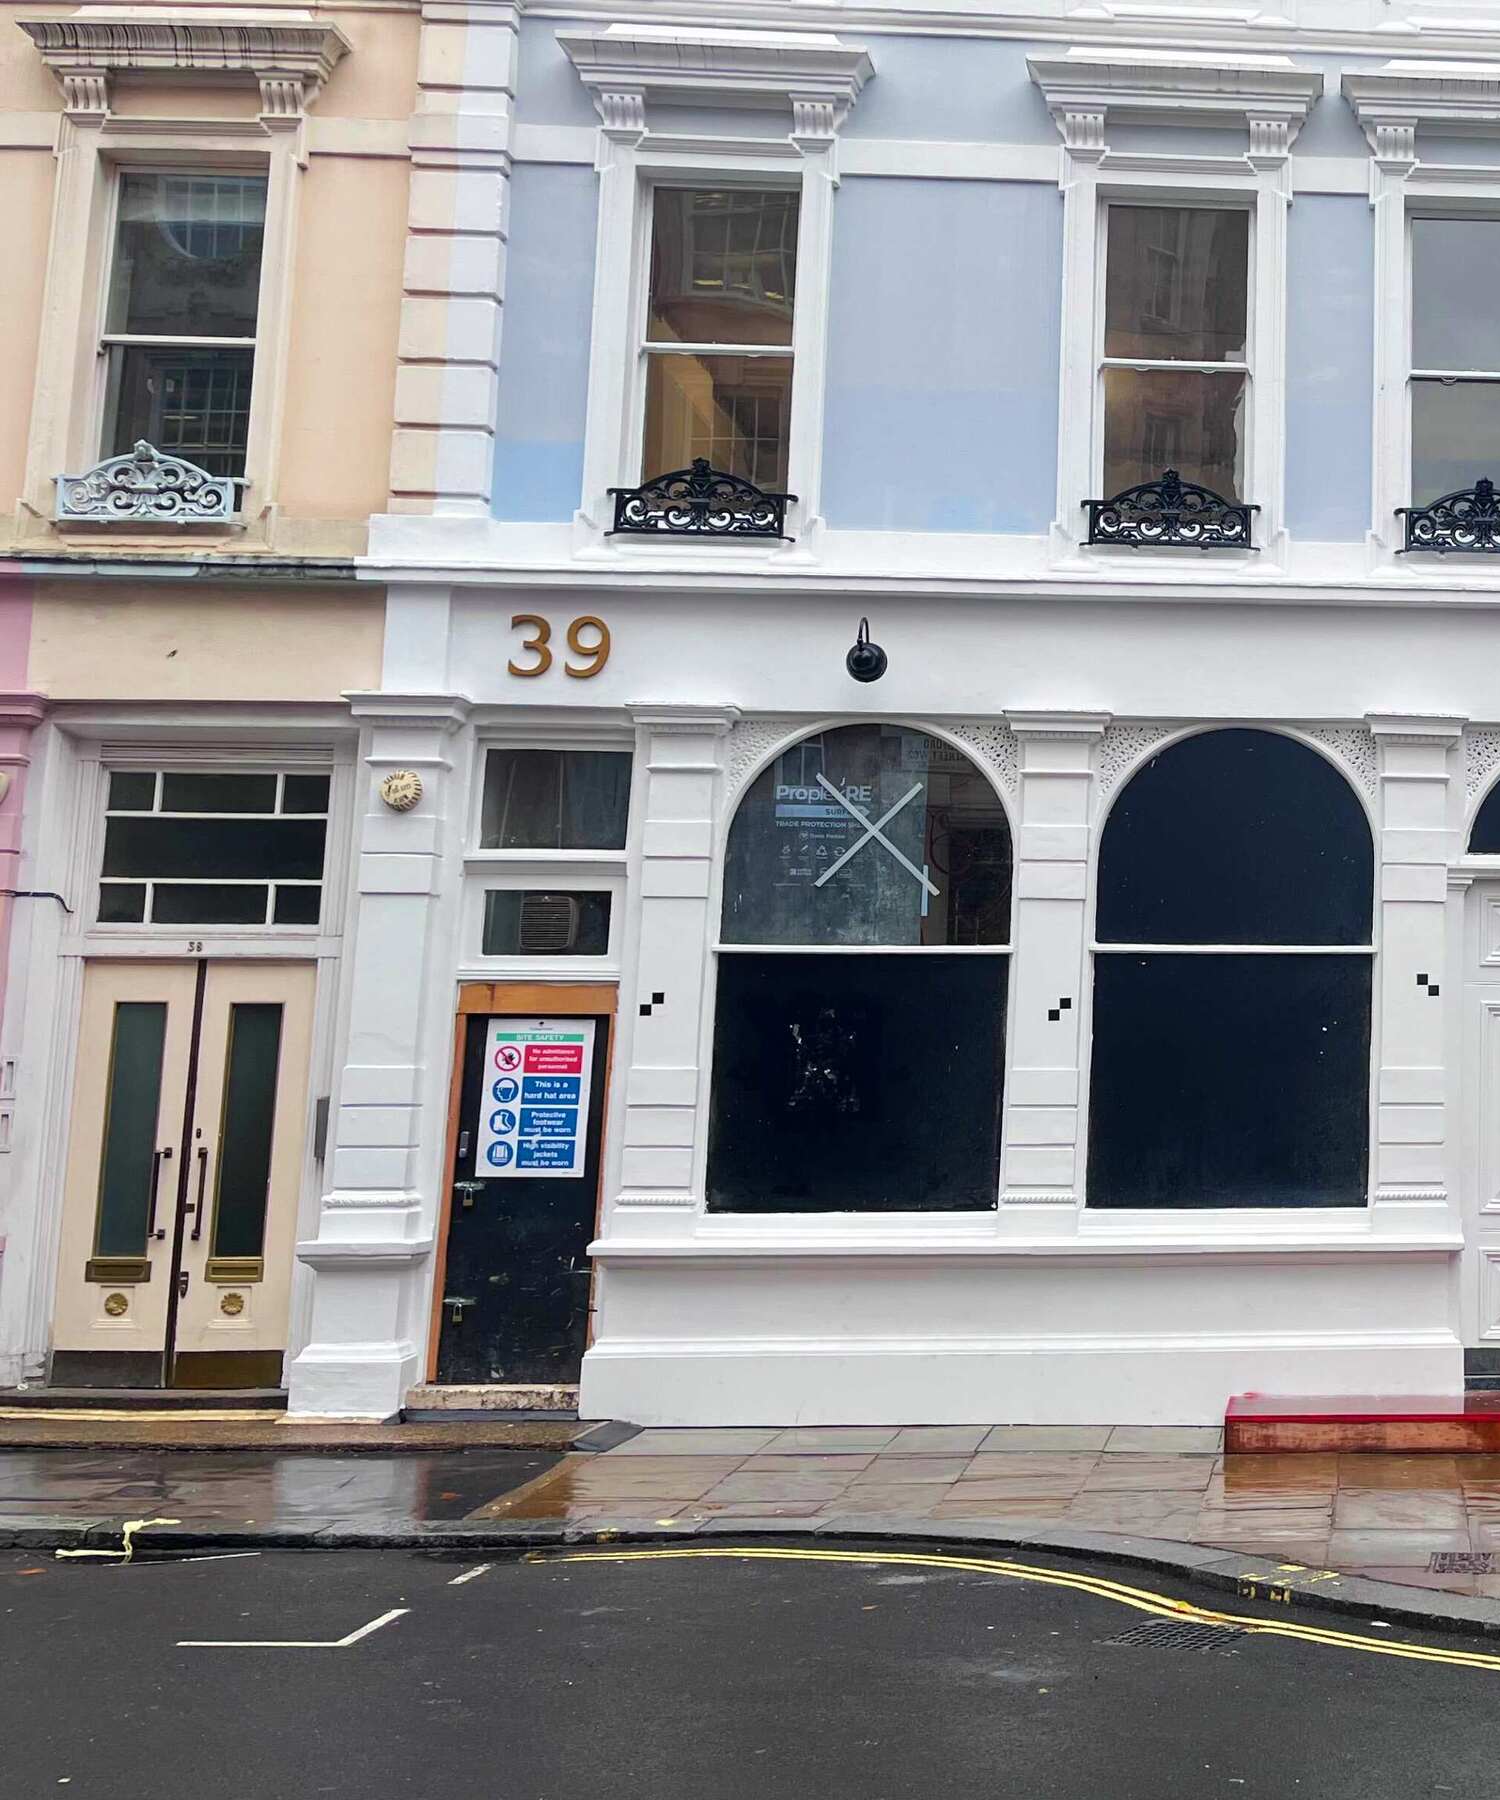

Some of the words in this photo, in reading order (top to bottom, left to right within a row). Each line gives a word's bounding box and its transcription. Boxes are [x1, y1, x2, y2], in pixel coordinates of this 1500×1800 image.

[508, 614, 611, 678] 39
[776, 820, 799, 828] TRADE
[187, 941, 203, 952] 38
[535, 1080, 552, 1088] This
